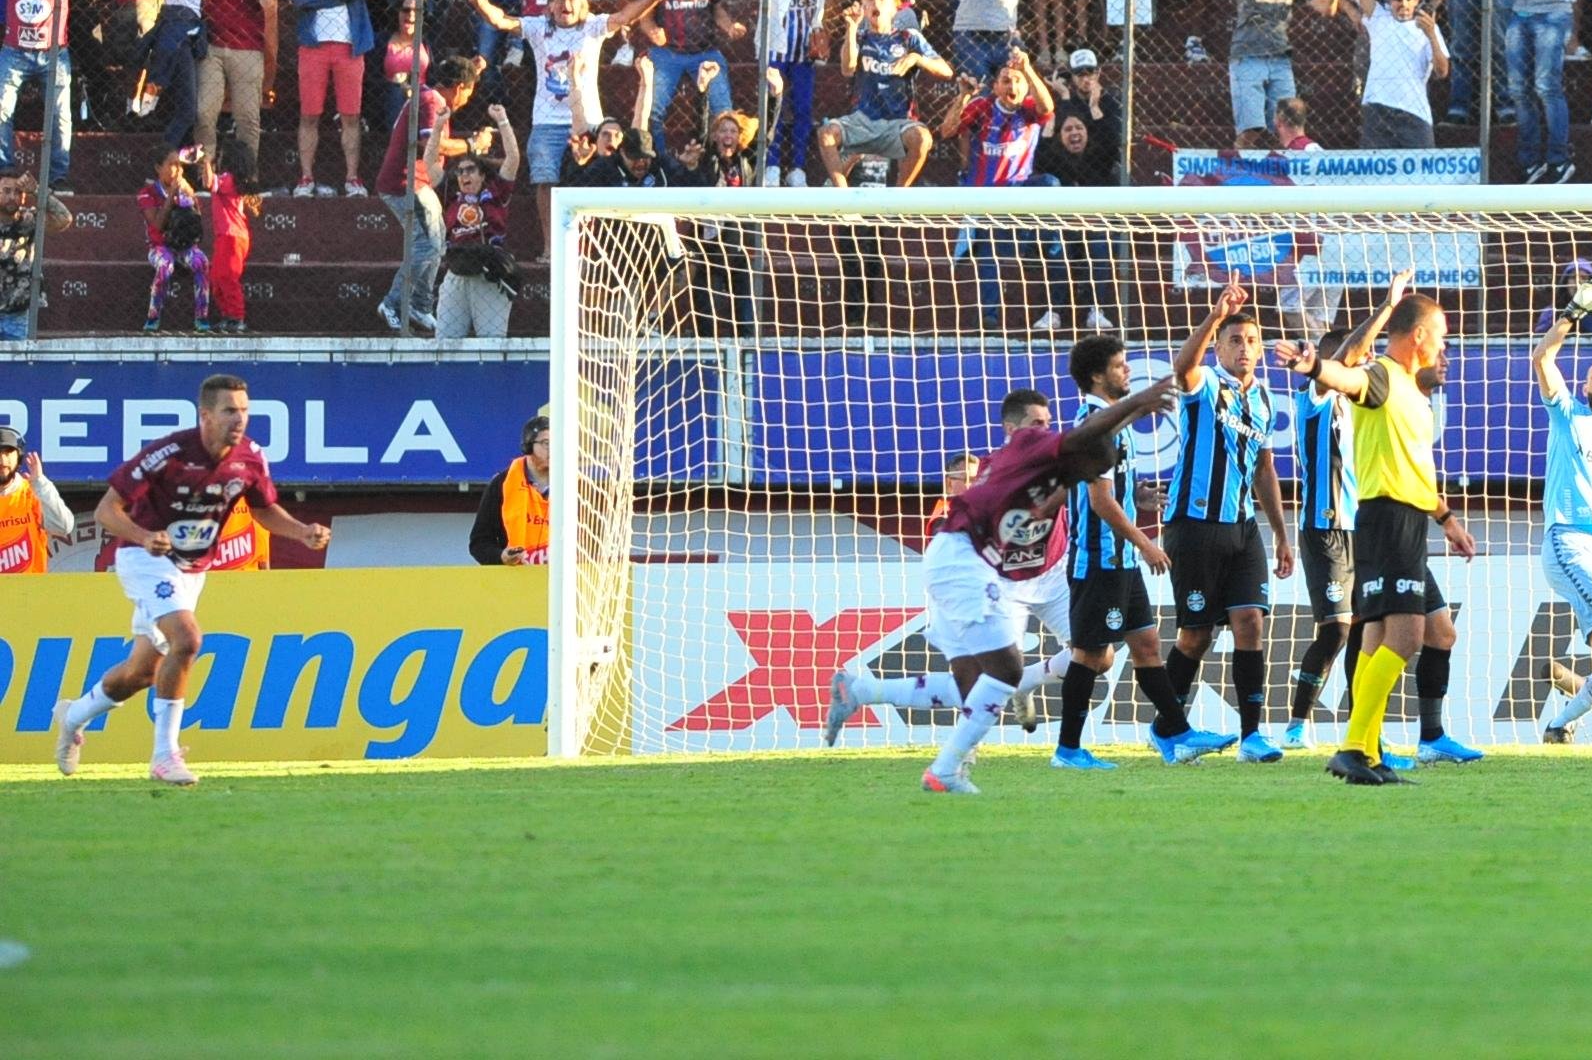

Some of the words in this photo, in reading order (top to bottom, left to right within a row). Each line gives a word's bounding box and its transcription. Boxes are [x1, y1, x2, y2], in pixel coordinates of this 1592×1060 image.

[1177, 155, 1310, 177] SIMPLESMENTE
[1315, 155, 1398, 176] AMAMOS
[1402, 155, 1416, 175] O
[1421, 154, 1481, 175] NOSSO
[76, 212, 108, 229] 092
[264, 212, 297, 230] 094
[1307, 270, 1367, 284] TURMA
